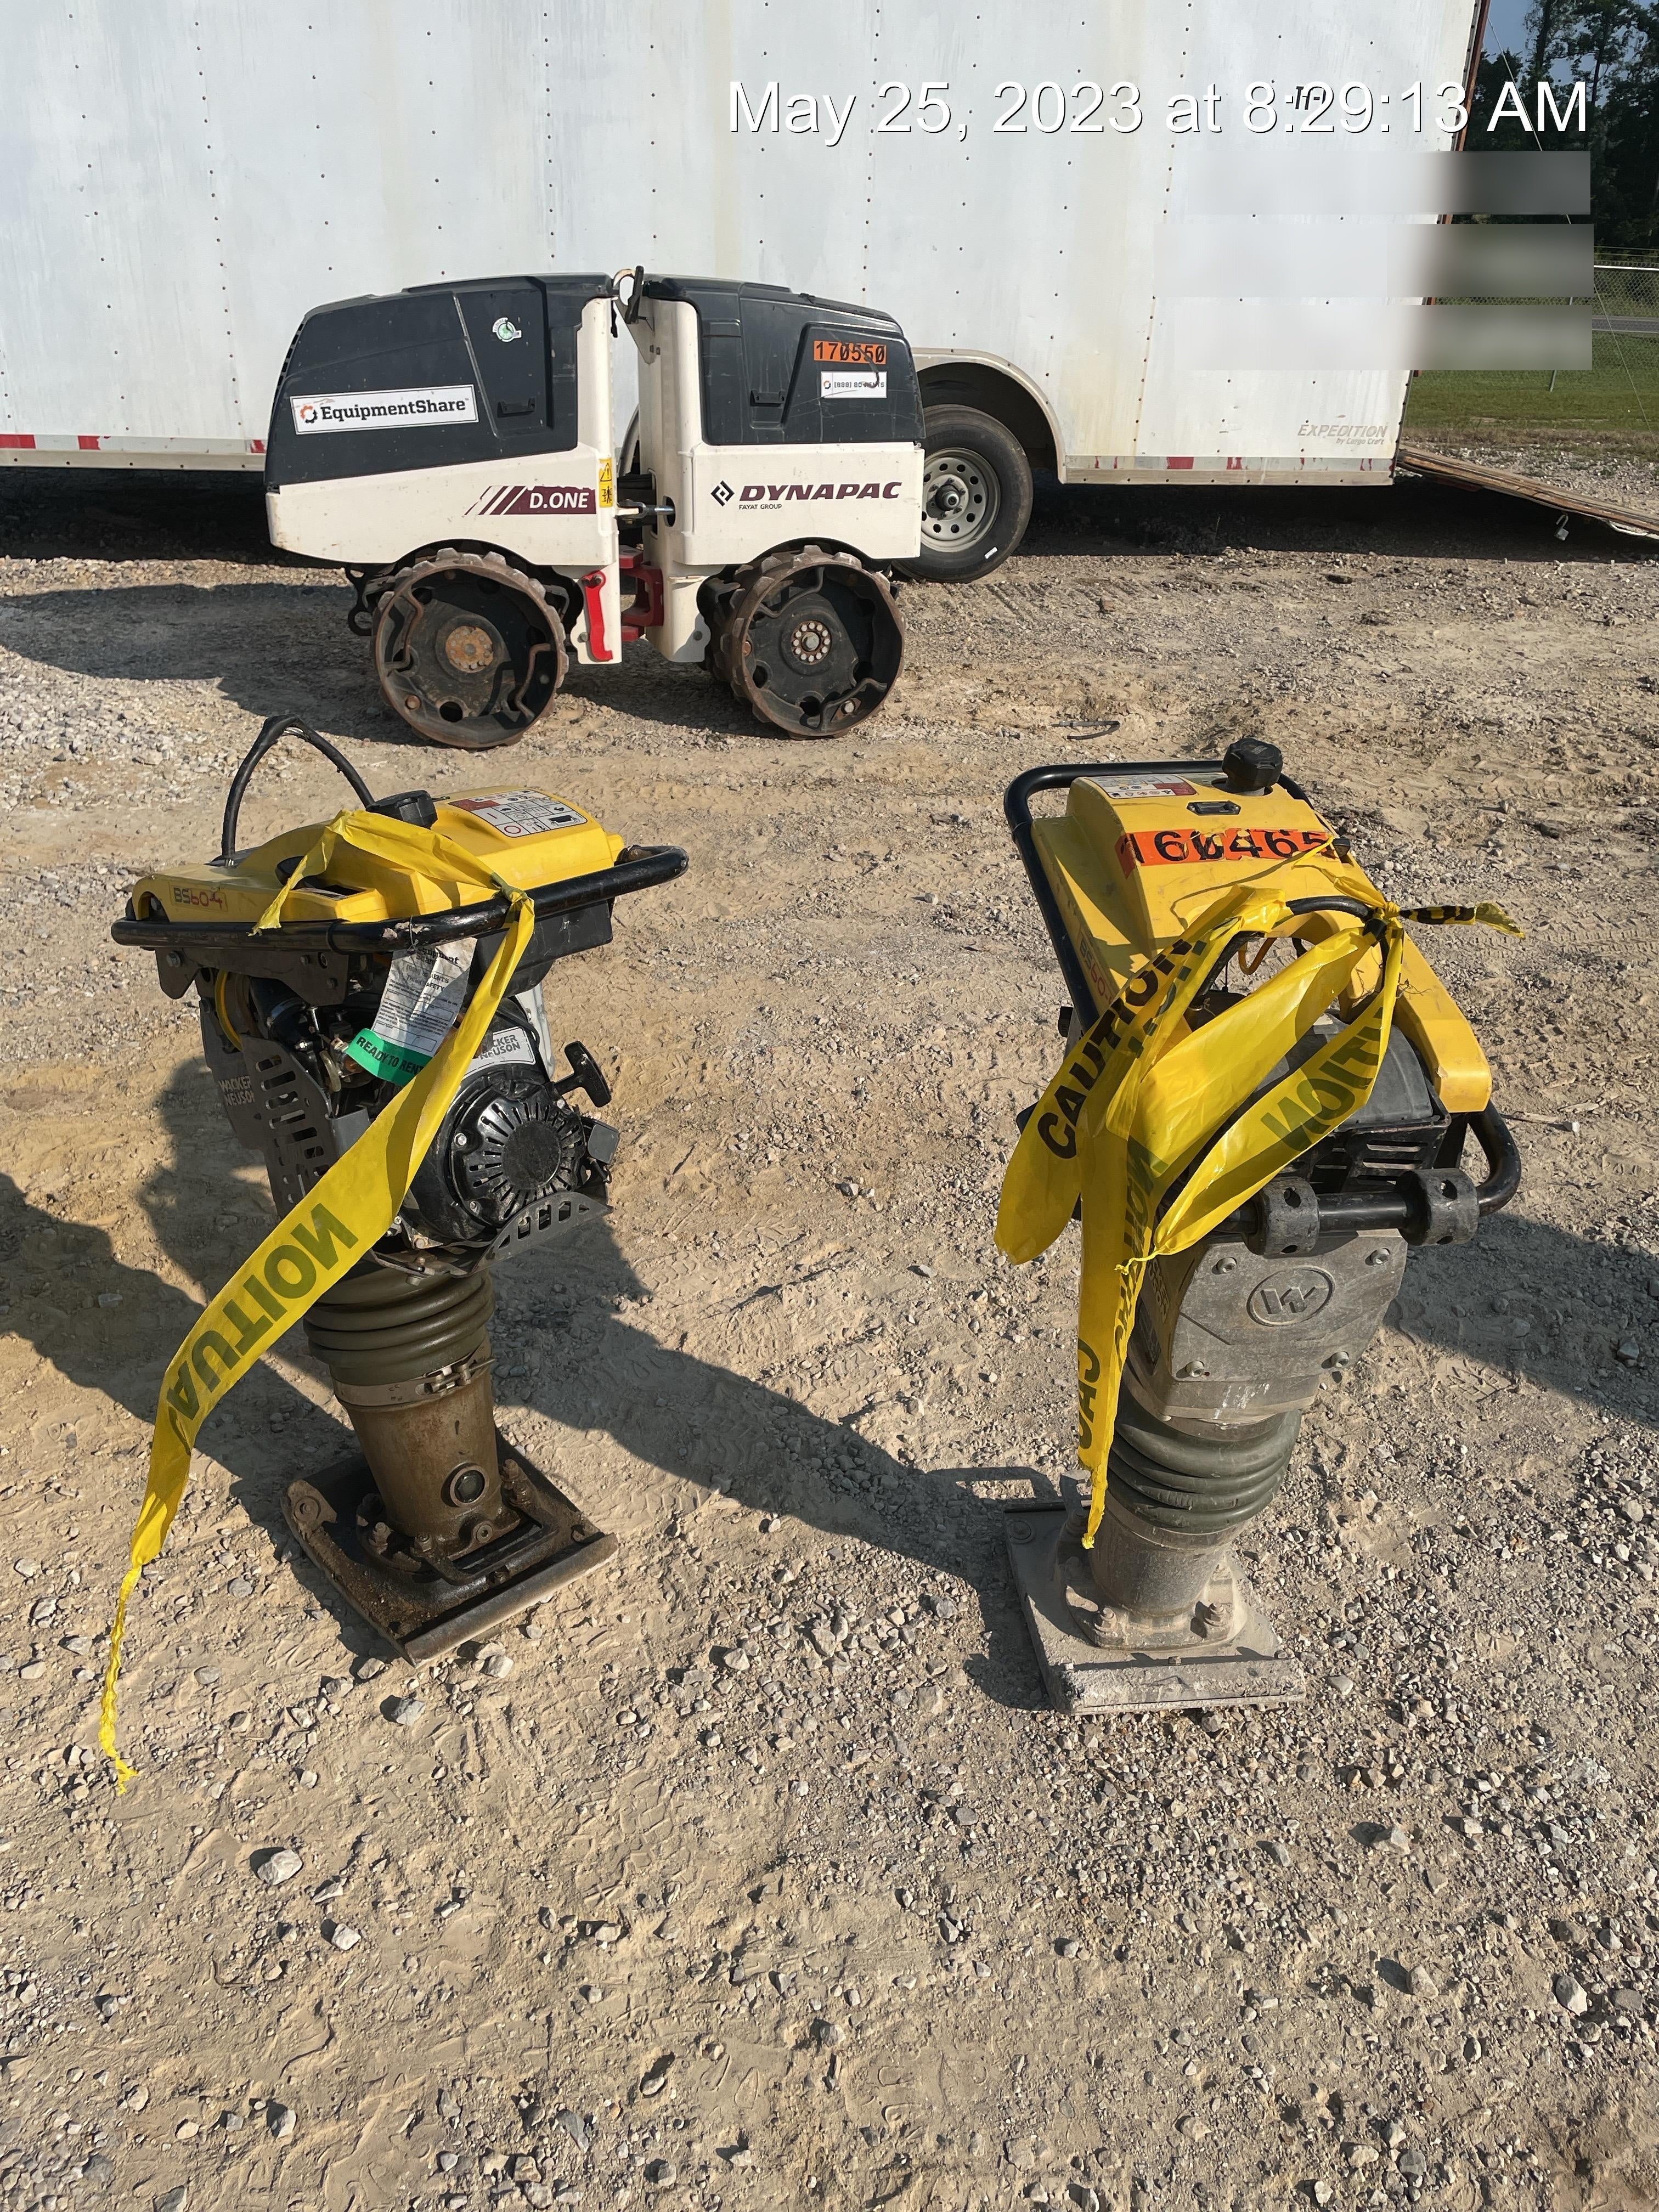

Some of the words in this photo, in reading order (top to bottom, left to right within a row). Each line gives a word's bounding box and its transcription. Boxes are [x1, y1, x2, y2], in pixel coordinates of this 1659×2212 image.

[816, 342, 885, 363] 170550
[320, 398, 466, 420] EquipmentShare
[1297, 425, 1388, 437] EXPEDITION
[740, 482, 902, 500] DYNAPAC
[529, 492, 589, 509] D.ONE
[493, 1035, 518, 1047] CKER
[356, 1036, 387, 1064] READY
[388, 1054, 400, 1068] TO
